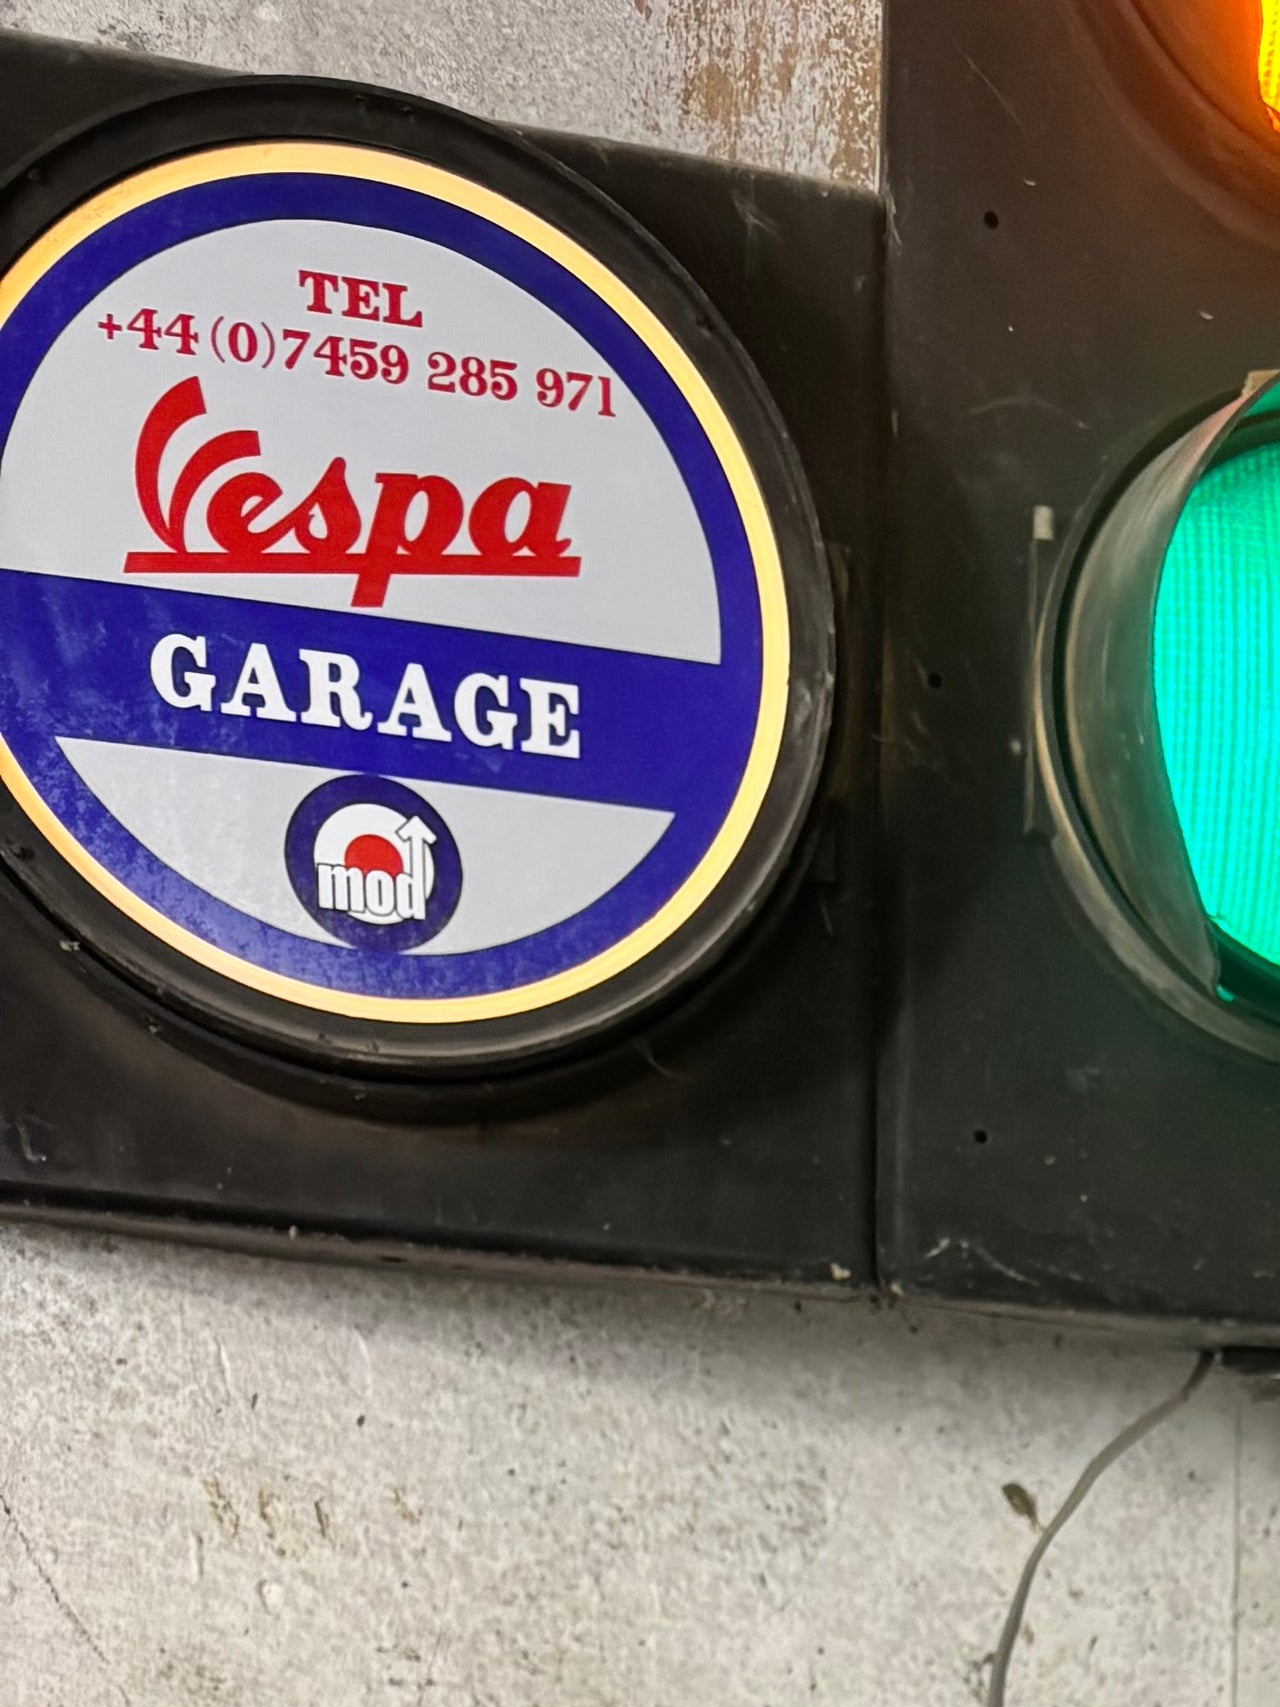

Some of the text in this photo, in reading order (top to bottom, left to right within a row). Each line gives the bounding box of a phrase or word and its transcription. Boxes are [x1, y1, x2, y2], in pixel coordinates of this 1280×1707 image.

[298, 270, 423, 329] TEL
[427, 352, 518, 402] 285
[535, 368, 615, 418] 971
[123, 375, 582, 609] Vespa
[150, 633, 581, 760] GARAGE
[316, 815, 437, 921] mod
